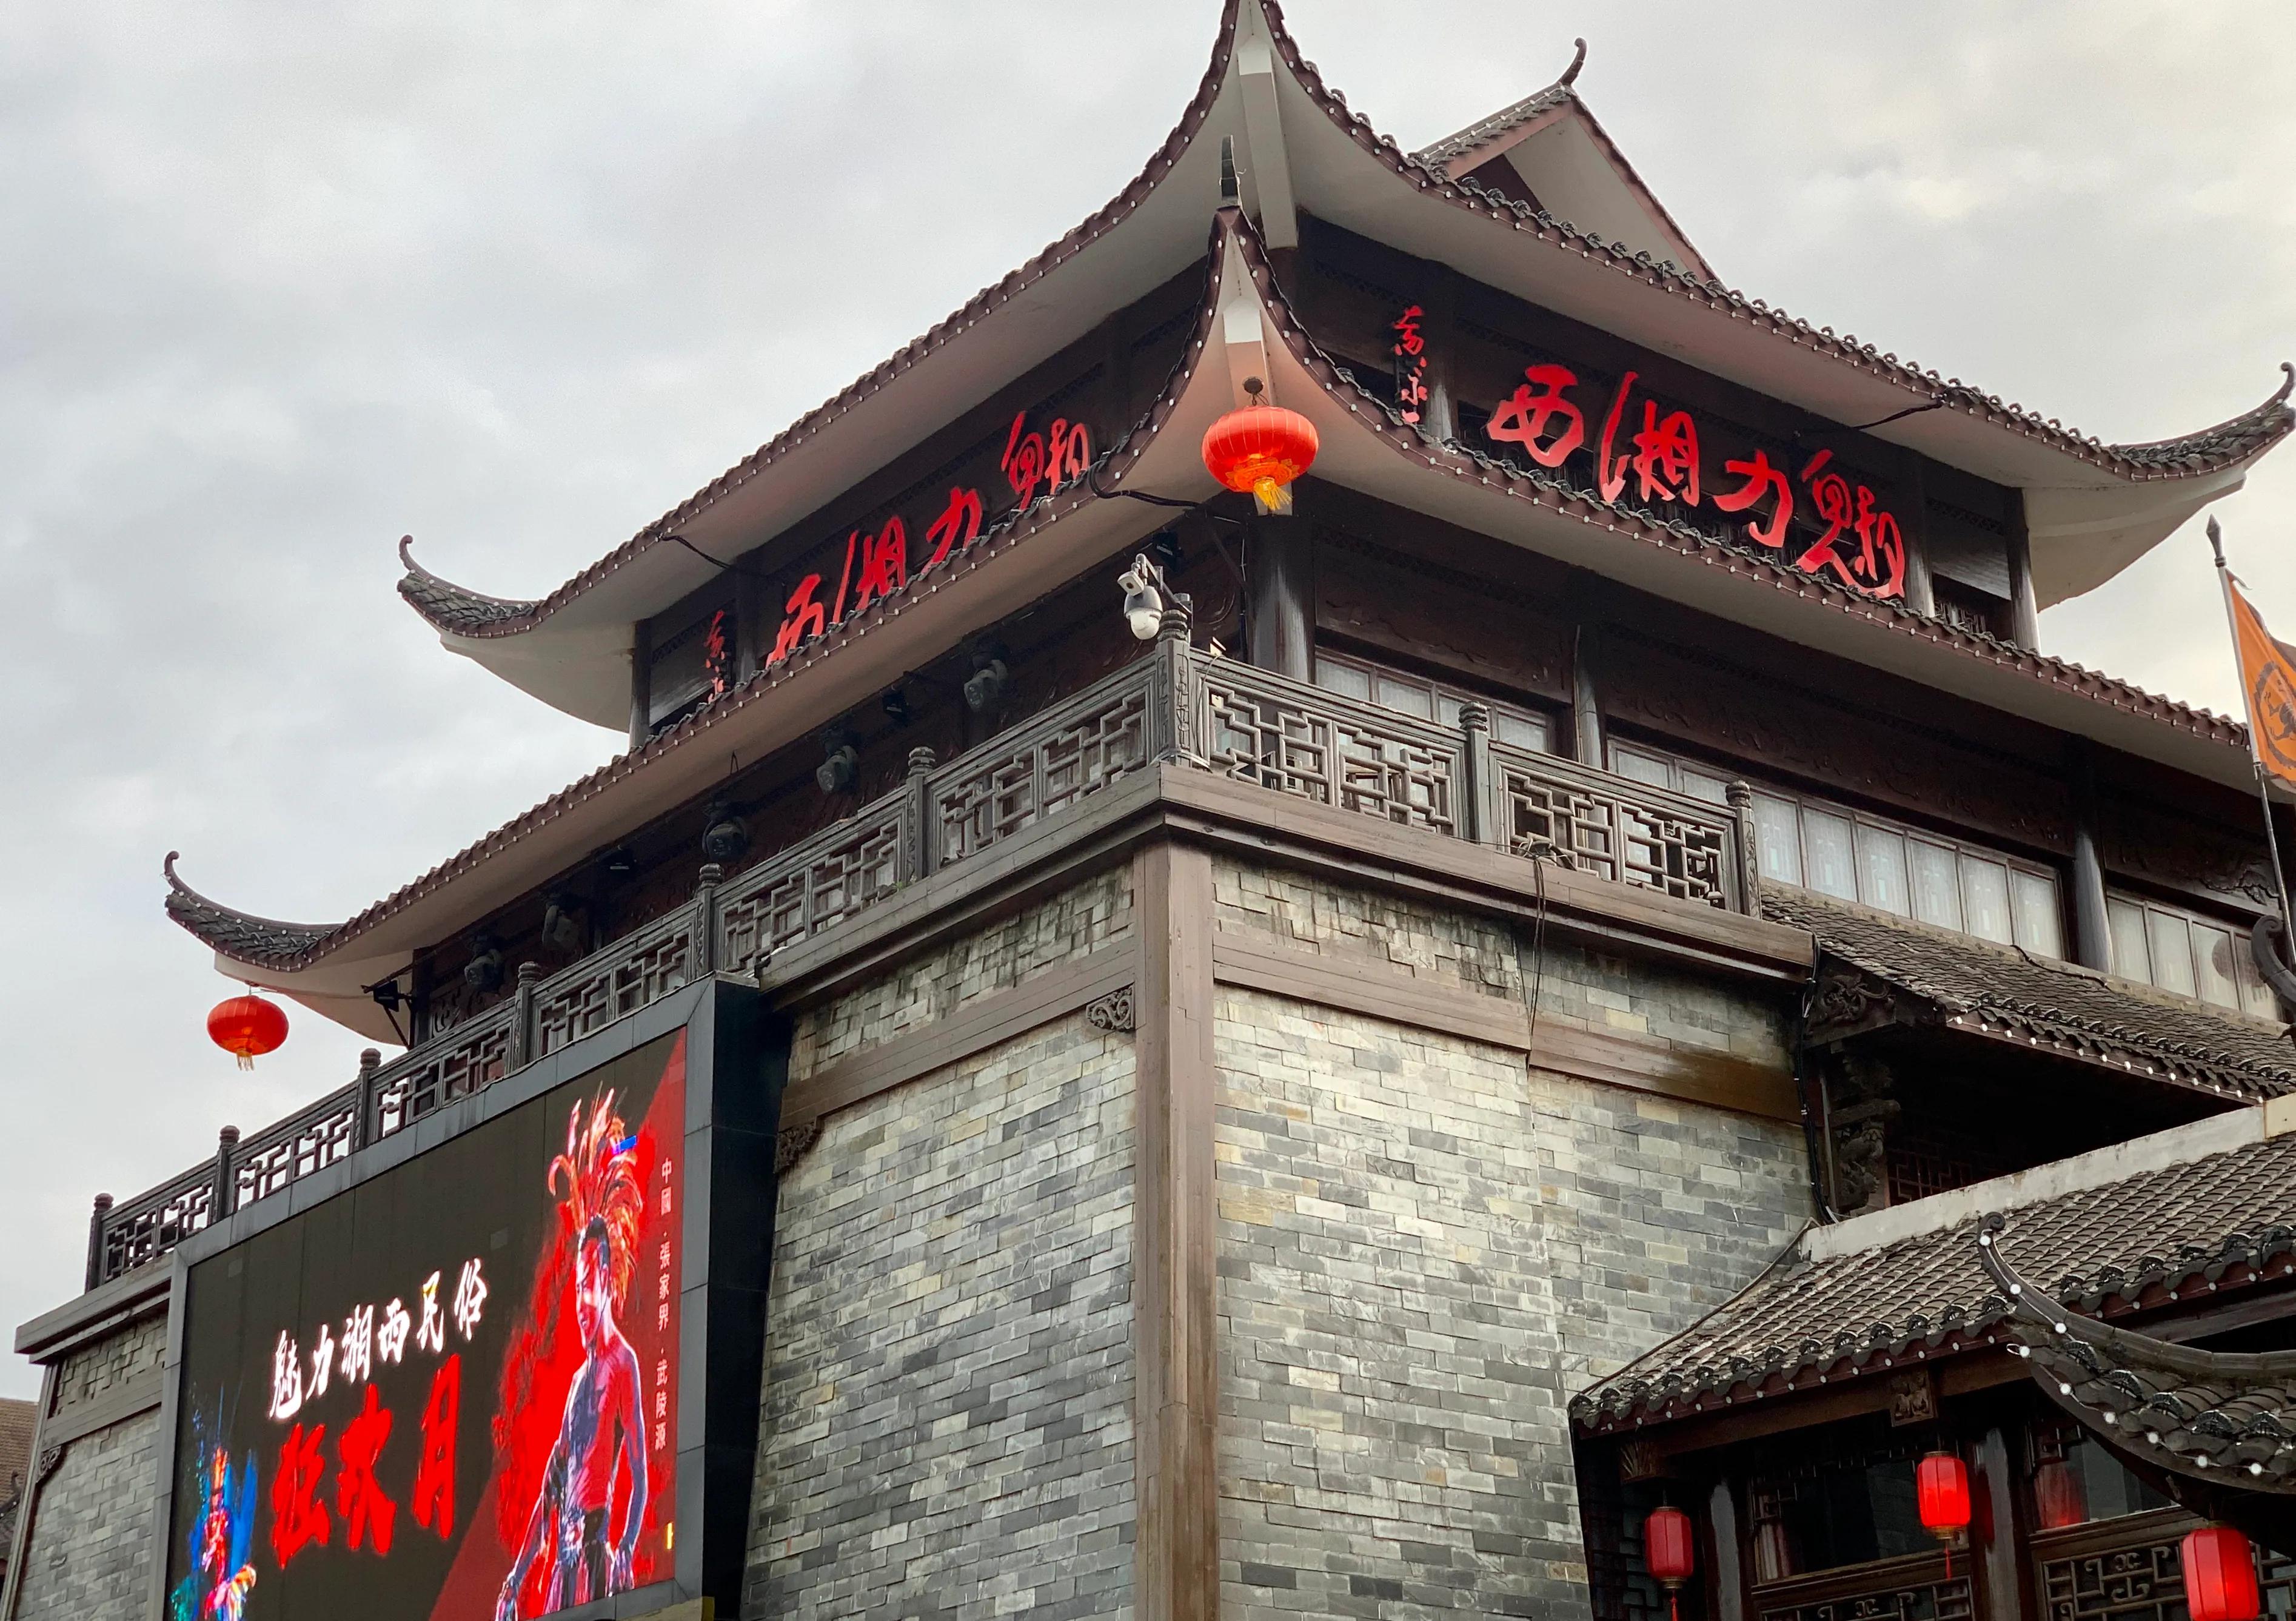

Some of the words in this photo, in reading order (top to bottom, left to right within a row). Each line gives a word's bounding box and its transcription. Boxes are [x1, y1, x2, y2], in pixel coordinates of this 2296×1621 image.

[269, 1257, 487, 1420] 魅力湘西民俗
